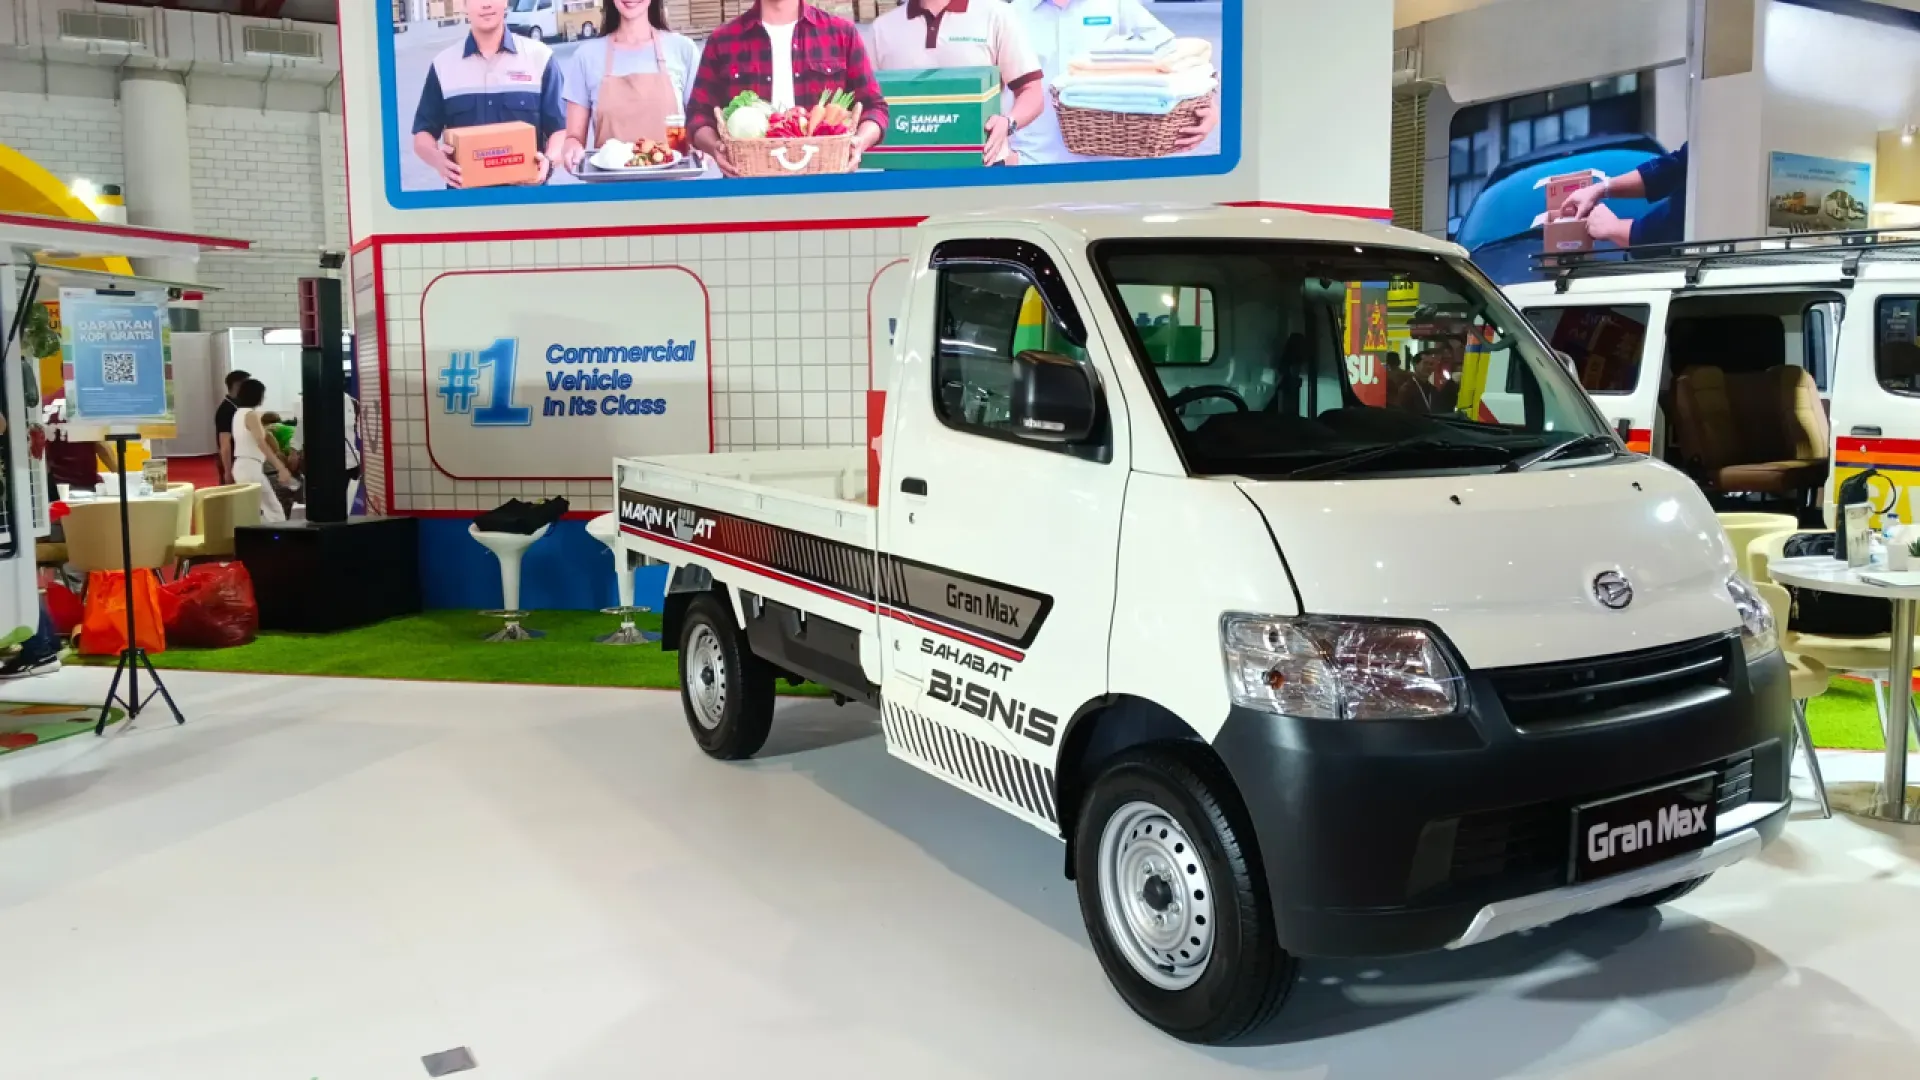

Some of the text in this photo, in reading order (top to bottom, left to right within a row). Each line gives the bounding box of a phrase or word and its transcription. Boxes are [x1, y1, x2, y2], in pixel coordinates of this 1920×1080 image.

[911, 113, 960, 124] SAHABAT
[911, 124, 940, 133] MART
[78, 320, 153, 331] DAPATKAN
[80, 331, 154, 342] KOPI GRATIS!
[546, 340, 697, 364] Commercial
[546, 368, 633, 391] Vehicle
[1345, 354, 1379, 385] SU.
[437, 337, 532, 426] #1
[543, 395, 667, 416] In Its Class
[946, 583, 1020, 628] Gran Max
[920, 637, 1013, 682] SAHABAT
[1588, 803, 1708, 862] Gran Max
